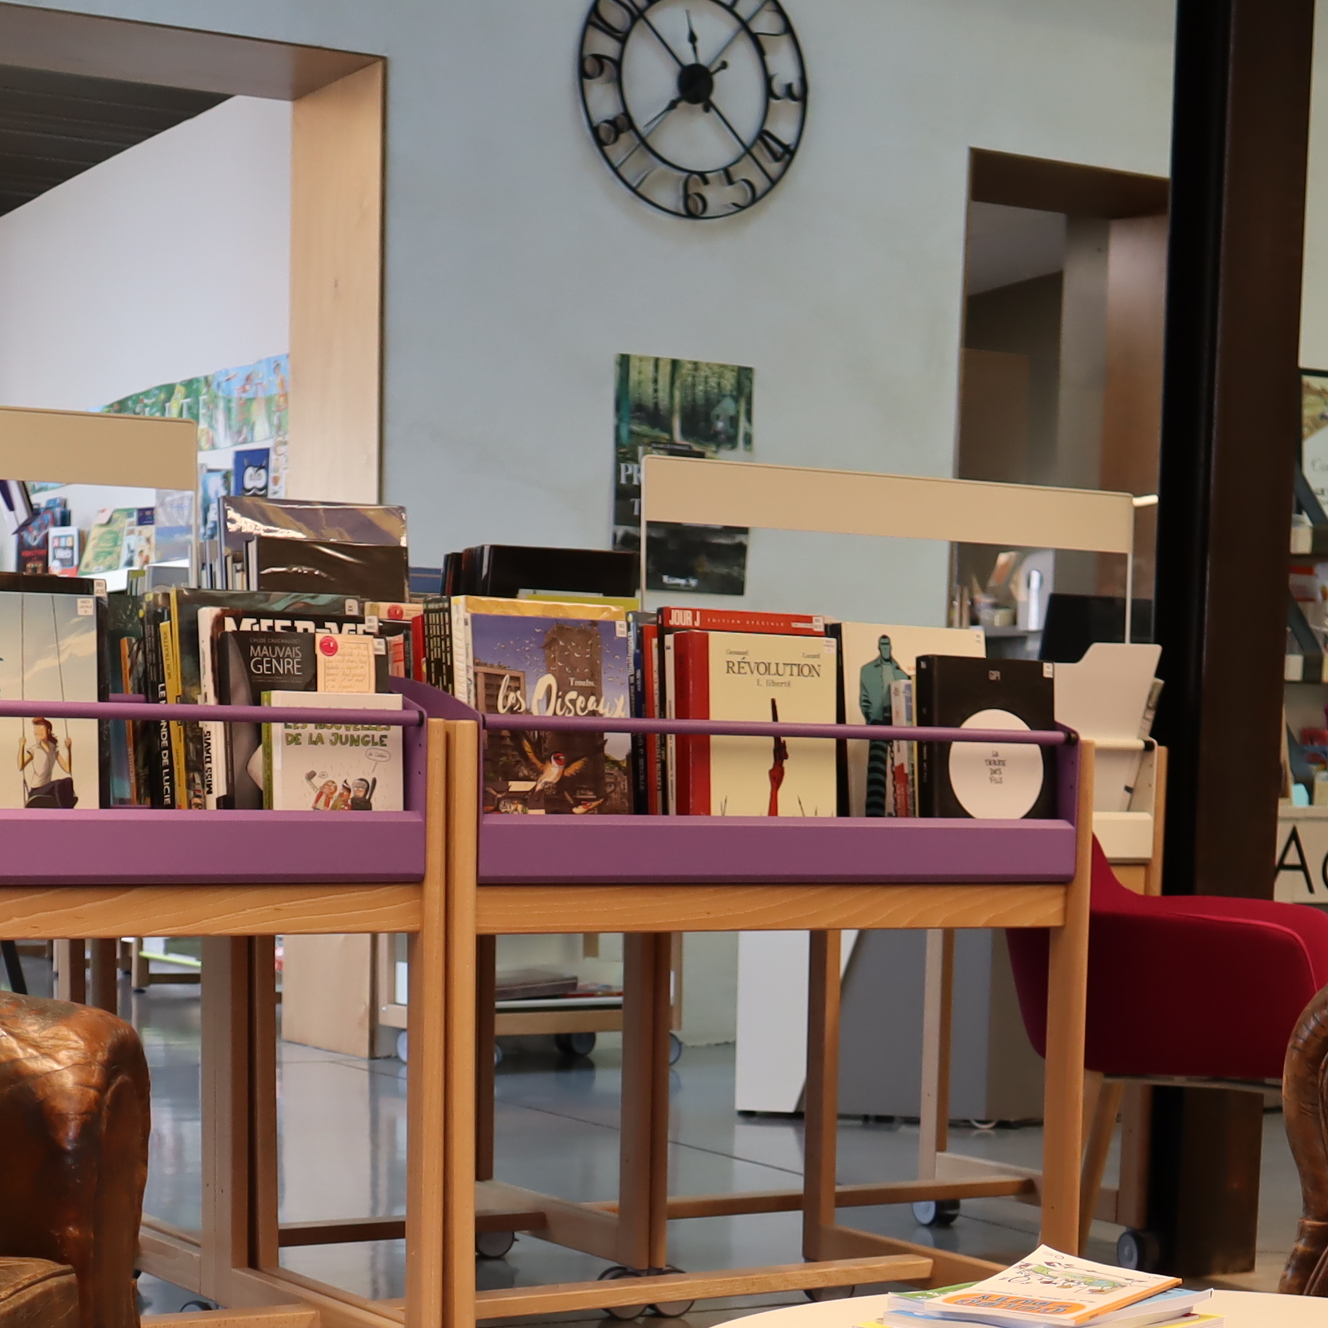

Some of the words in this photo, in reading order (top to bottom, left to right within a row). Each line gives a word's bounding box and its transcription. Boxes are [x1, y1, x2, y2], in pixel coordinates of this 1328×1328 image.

[669, 609, 693, 627] JOUR
[694, 611, 700, 627] J
[250, 645, 302, 658] MAUVAIS
[250, 657, 302, 675] GENRE
[725, 657, 821, 678] RÉVOLUTION
[158, 683, 166, 698] LE
[531, 673, 626, 718] Oiseaux
[285, 733, 302, 746] DE
[308, 733, 325, 746] LA
[329, 733, 388, 747] JUNGLE
[161, 751, 169, 767] DE
[162, 767, 171, 806] LUCIE
[204, 767, 213, 795] MISS
